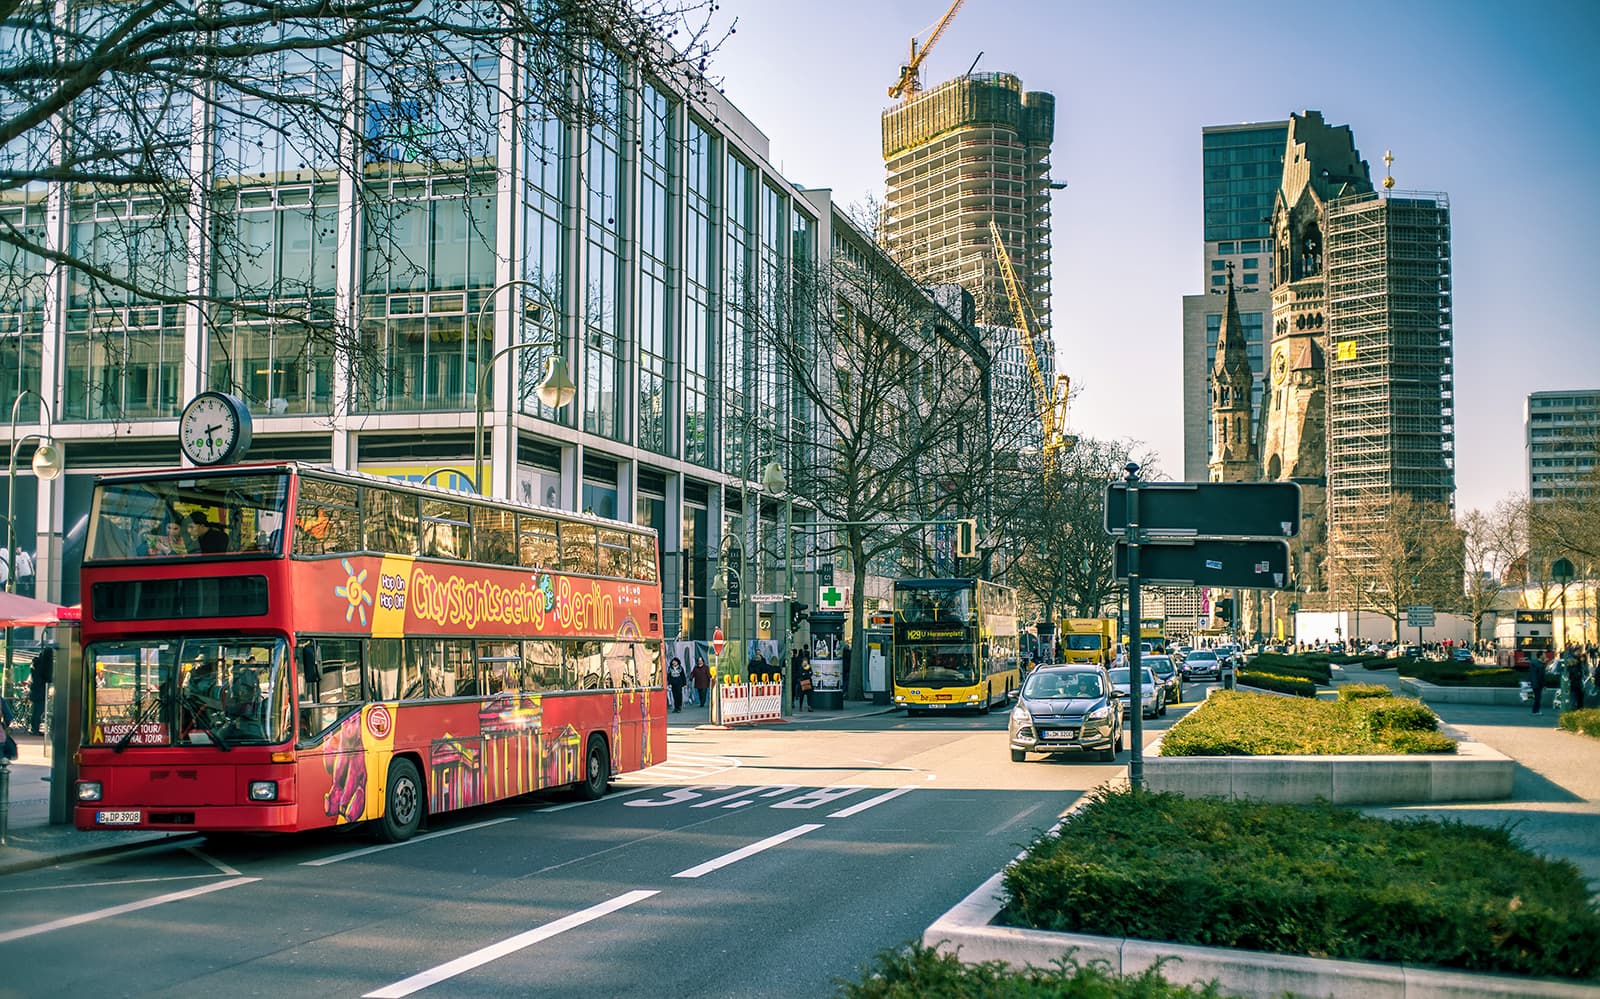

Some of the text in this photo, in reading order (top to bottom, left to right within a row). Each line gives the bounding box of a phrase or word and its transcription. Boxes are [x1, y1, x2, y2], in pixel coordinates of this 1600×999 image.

[382, 574, 406, 591] Hop On
[730, 550, 739, 605] ESPRIT
[380, 592, 405, 611] Hop Off
[412, 567, 615, 631] CitySightseeing Berlin
[907, 630, 921, 641] M29
[93, 725, 104, 744] A
[144, 734, 163, 743] TOUR
